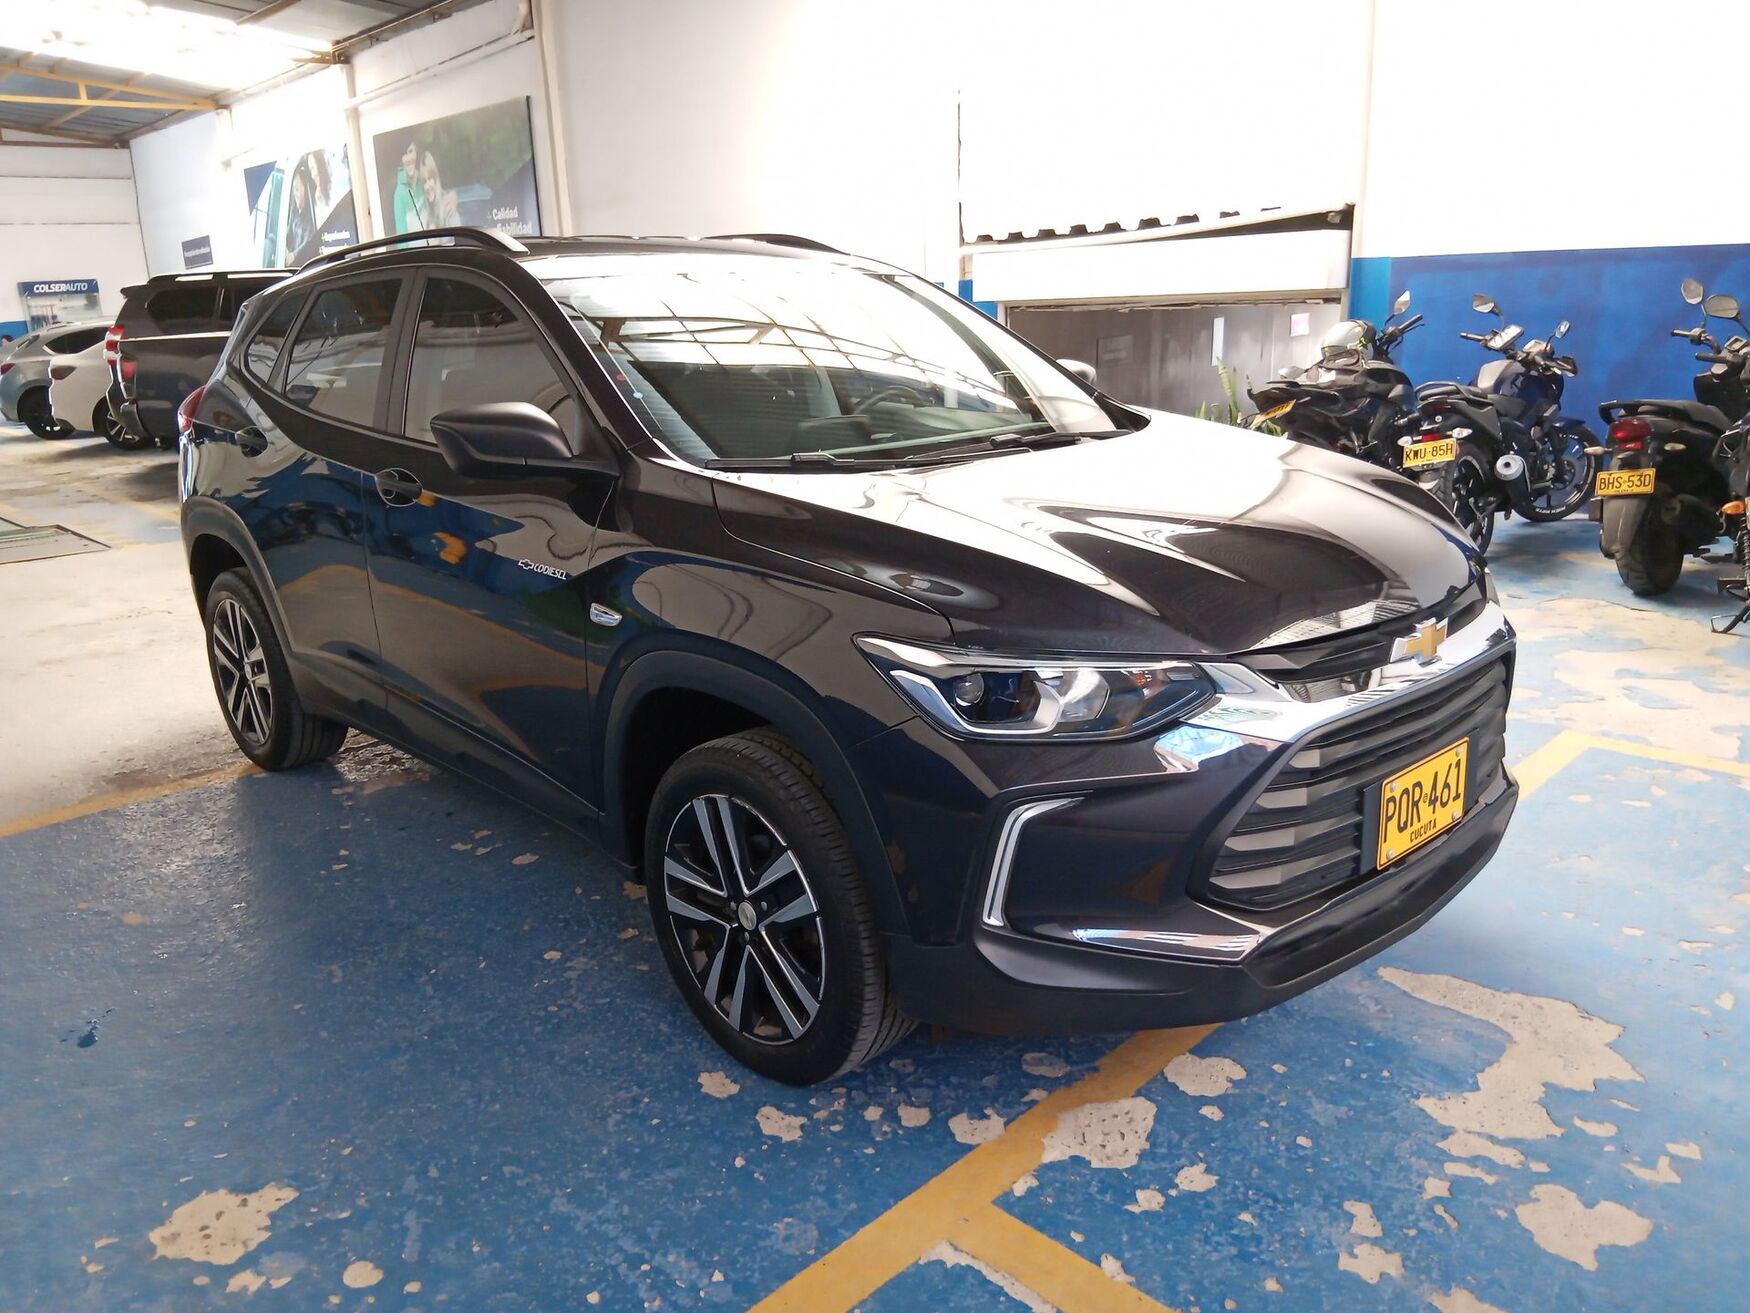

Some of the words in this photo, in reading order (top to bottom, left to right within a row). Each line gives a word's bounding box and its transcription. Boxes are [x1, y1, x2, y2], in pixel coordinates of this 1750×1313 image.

[492, 206, 519, 220] Calidad
[33, 282, 88, 293] COLSERAUTO
[1409, 818, 1437, 843] CUCUTA
